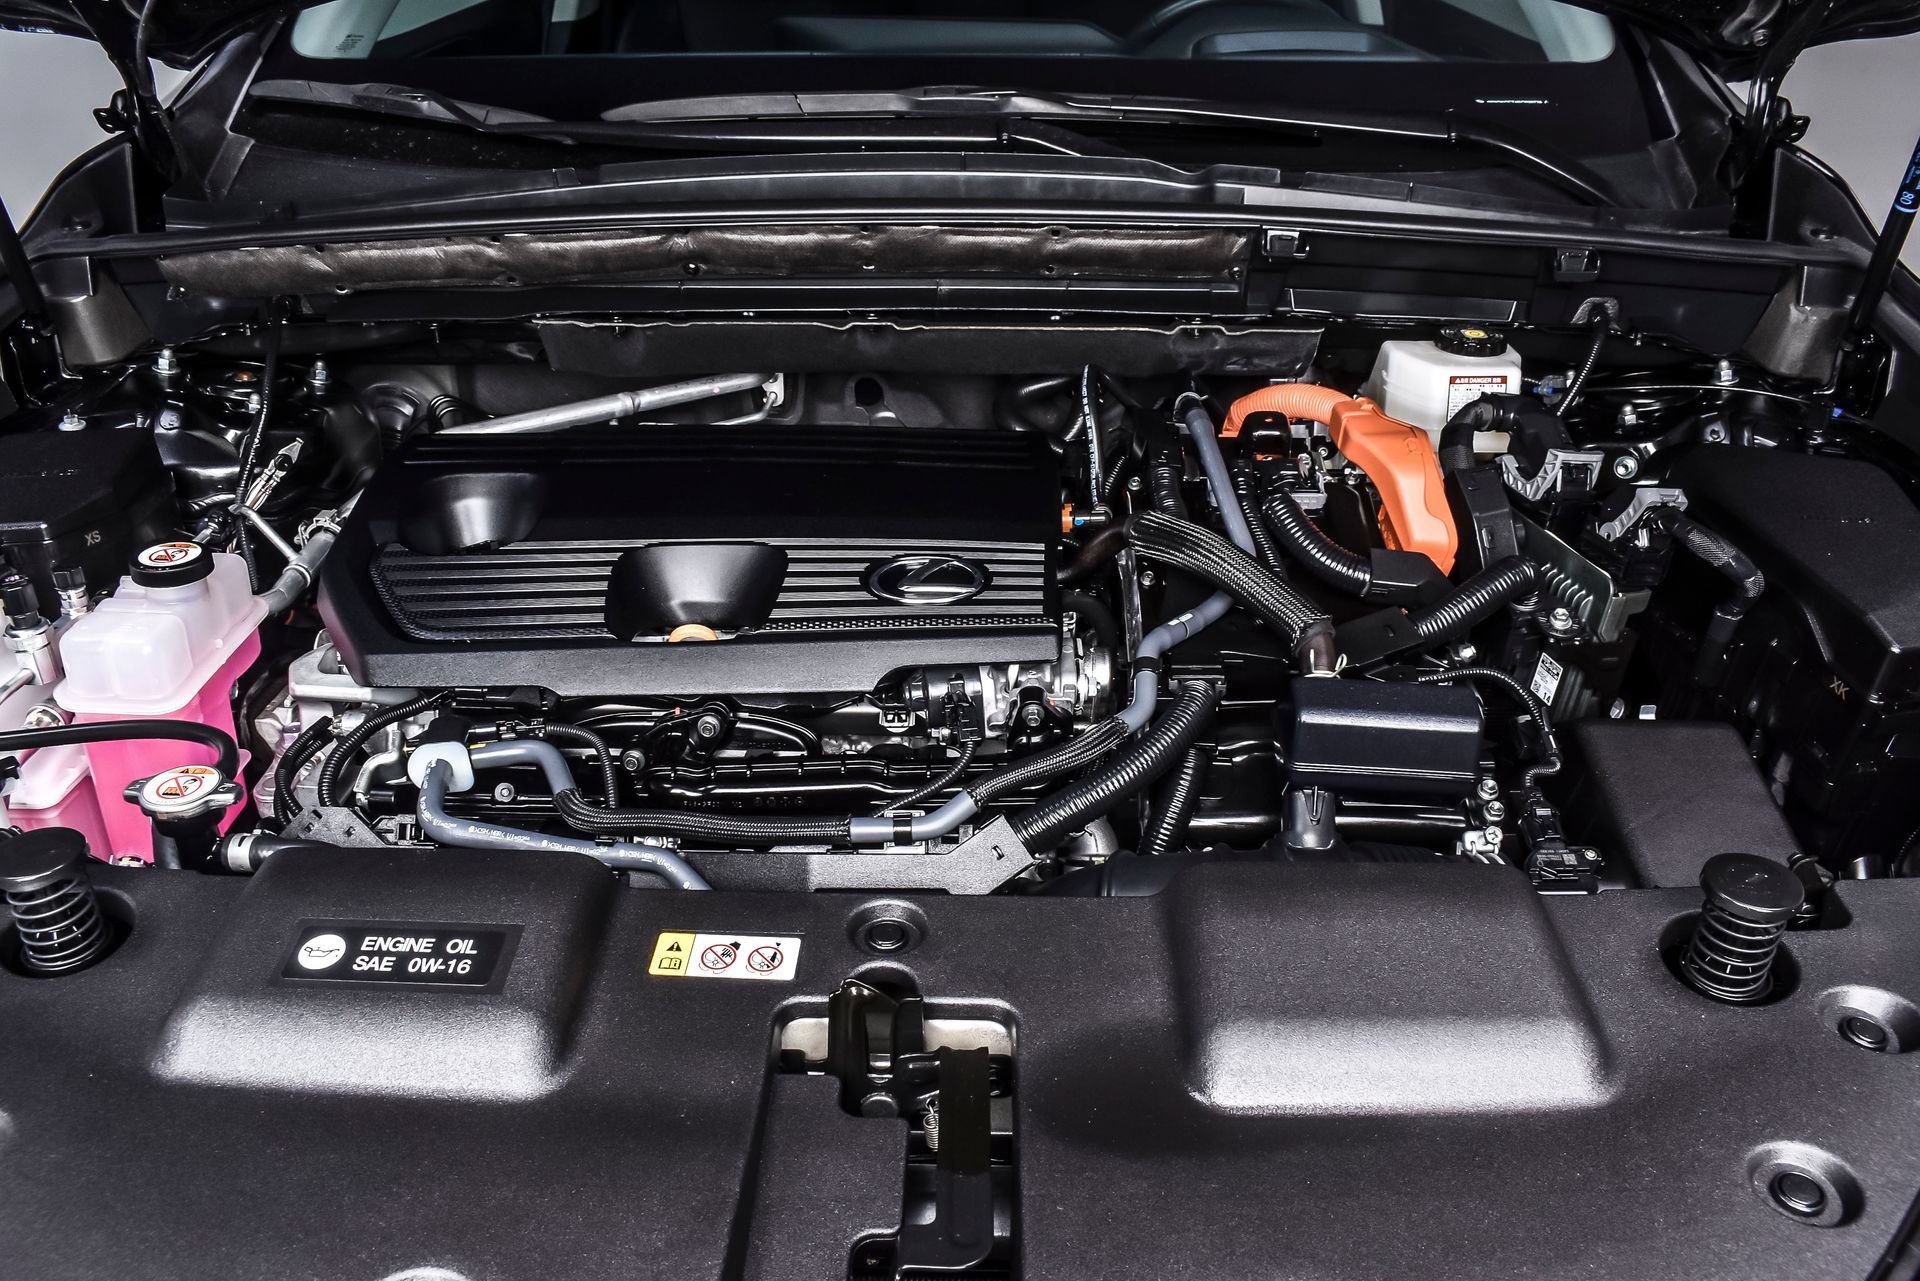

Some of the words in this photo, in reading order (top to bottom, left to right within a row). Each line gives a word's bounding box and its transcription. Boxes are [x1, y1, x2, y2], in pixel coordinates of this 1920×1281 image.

[84, 530, 102, 547] XS
[1829, 675, 1850, 700] XK
[1542, 691, 1551, 704] 14
[360, 936, 436, 953] ENGINE
[446, 939, 478, 955] OIL
[352, 956, 396, 972] SAE
[407, 957, 472, 974] 0W-16
